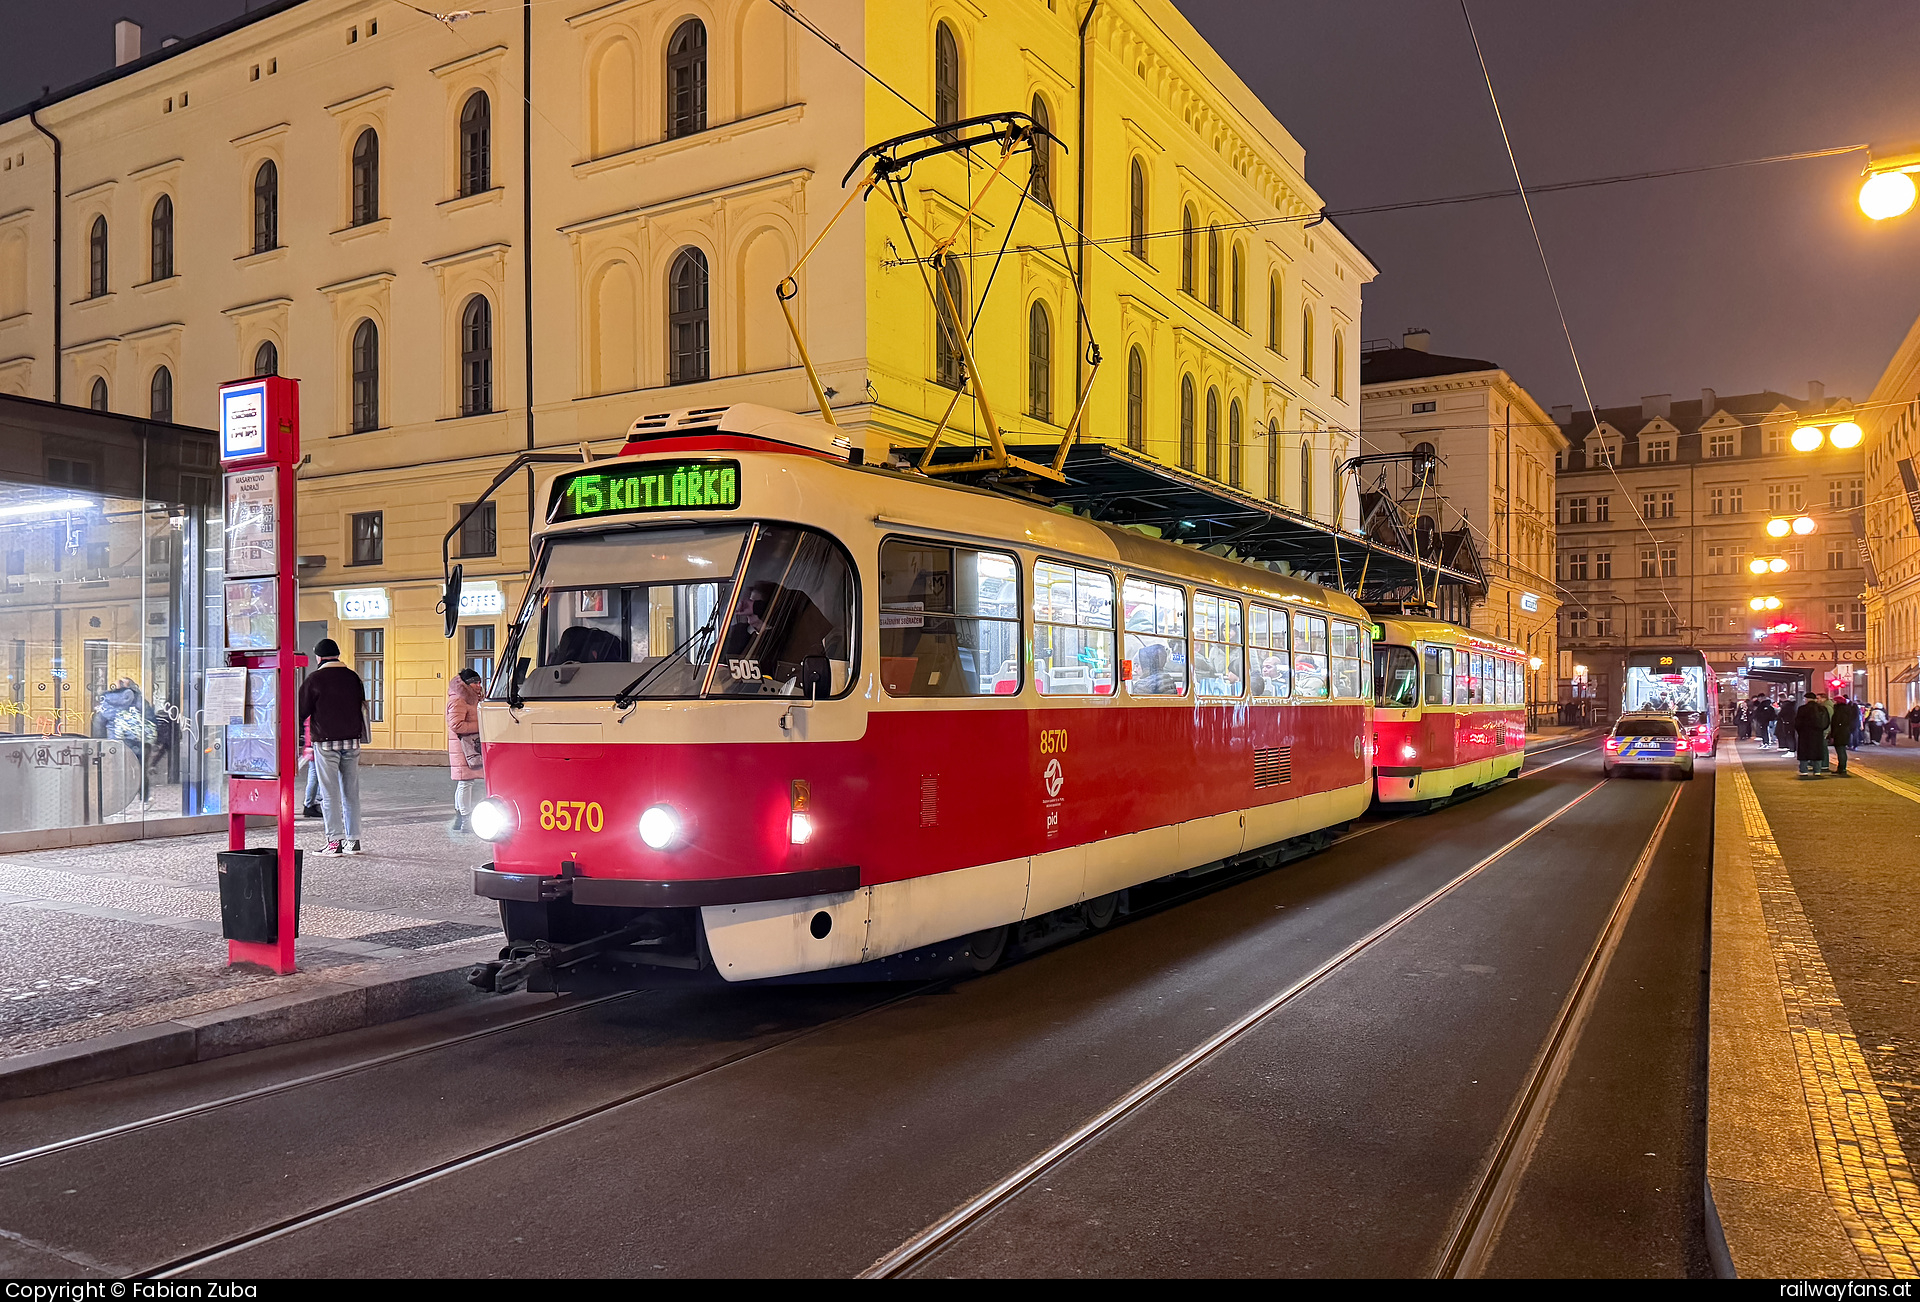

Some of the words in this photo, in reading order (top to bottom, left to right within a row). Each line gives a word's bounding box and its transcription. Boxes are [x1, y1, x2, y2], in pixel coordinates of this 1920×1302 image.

[566, 474, 603, 515] 15
[609, 464, 736, 510] KOTLÁŘKA
[460, 594, 497, 608] OFFEE
[728, 658, 762, 681] 505
[1660, 656, 1673, 665] 26
[1040, 728, 1068, 754] 8570
[539, 799, 604, 833] 8570
[1046, 811, 1058, 829] pid
